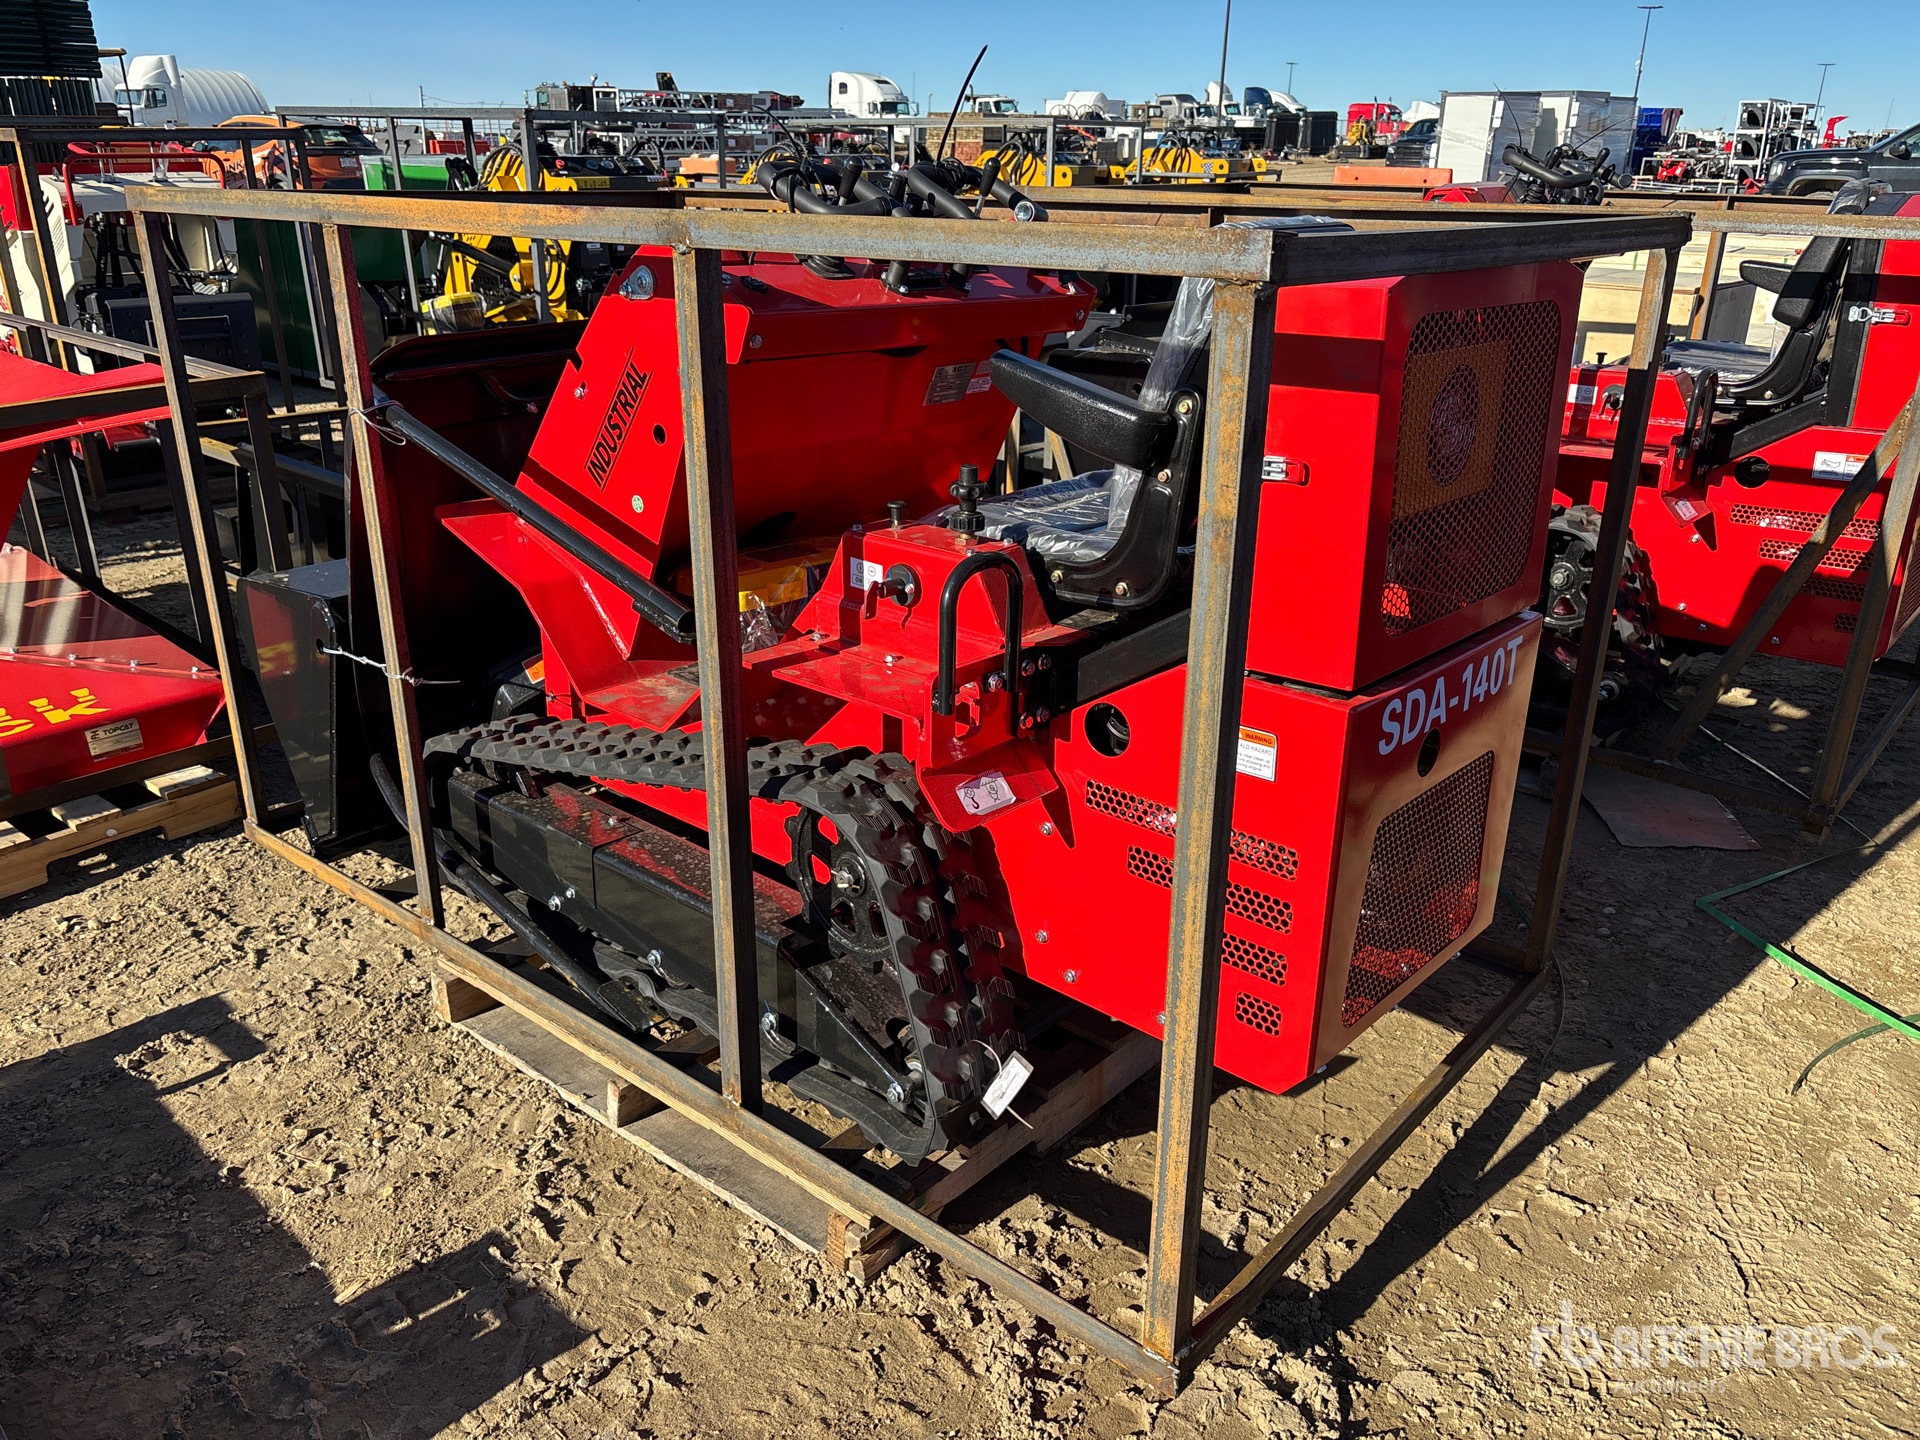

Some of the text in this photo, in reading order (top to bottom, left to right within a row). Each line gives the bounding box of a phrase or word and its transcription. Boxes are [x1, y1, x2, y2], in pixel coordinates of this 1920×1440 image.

[952, 365, 969, 373] AGT
[586, 361, 648, 488] INDUSTRIAL
[1378, 635, 1524, 756] SDA-140T
[102, 722, 134, 736] TOPCAT
[1245, 733, 1272, 744] WARNING
[1251, 746, 1272, 755] HAZARD
